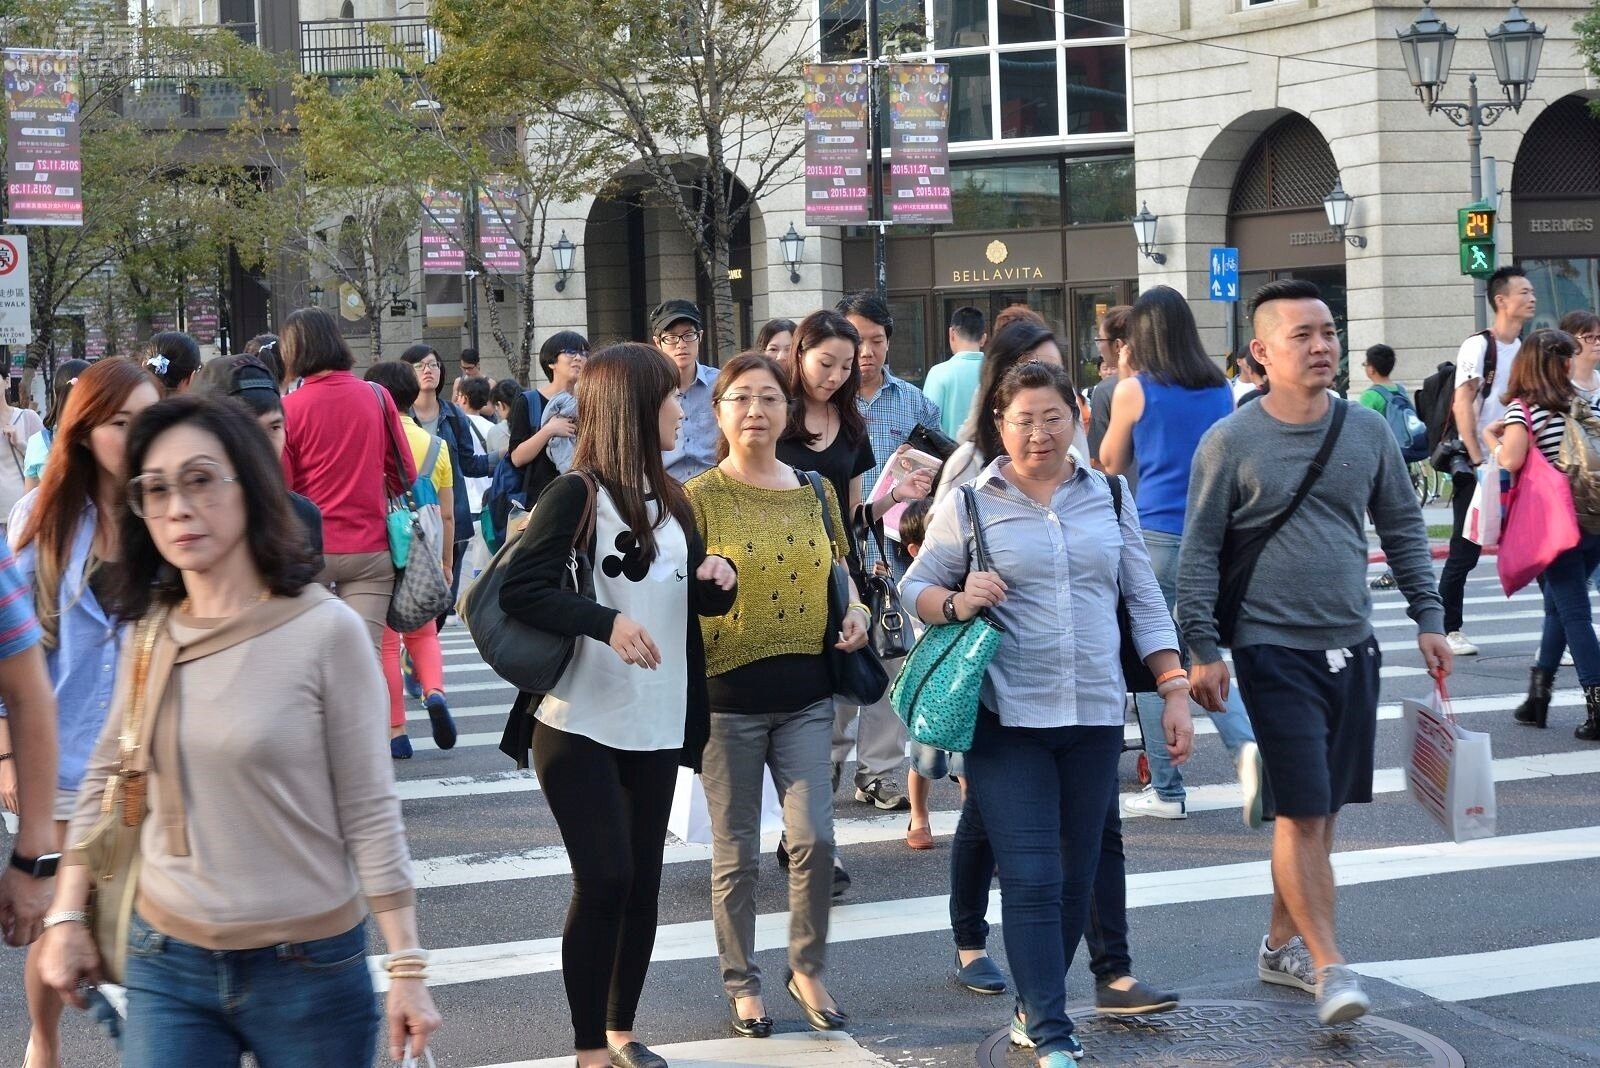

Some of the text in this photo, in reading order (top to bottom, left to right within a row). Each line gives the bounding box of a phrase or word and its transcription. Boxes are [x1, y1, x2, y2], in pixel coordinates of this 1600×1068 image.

[806, 165, 842, 175] 2015.11.27
[892, 164, 927, 174] 2015.11.27
[831, 188, 866, 197] 2015.11.29
[916, 187, 950, 196] 2015.11.29
[1466, 213, 1488, 236] 24
[953, 266, 1043, 282] BELLAVITA
